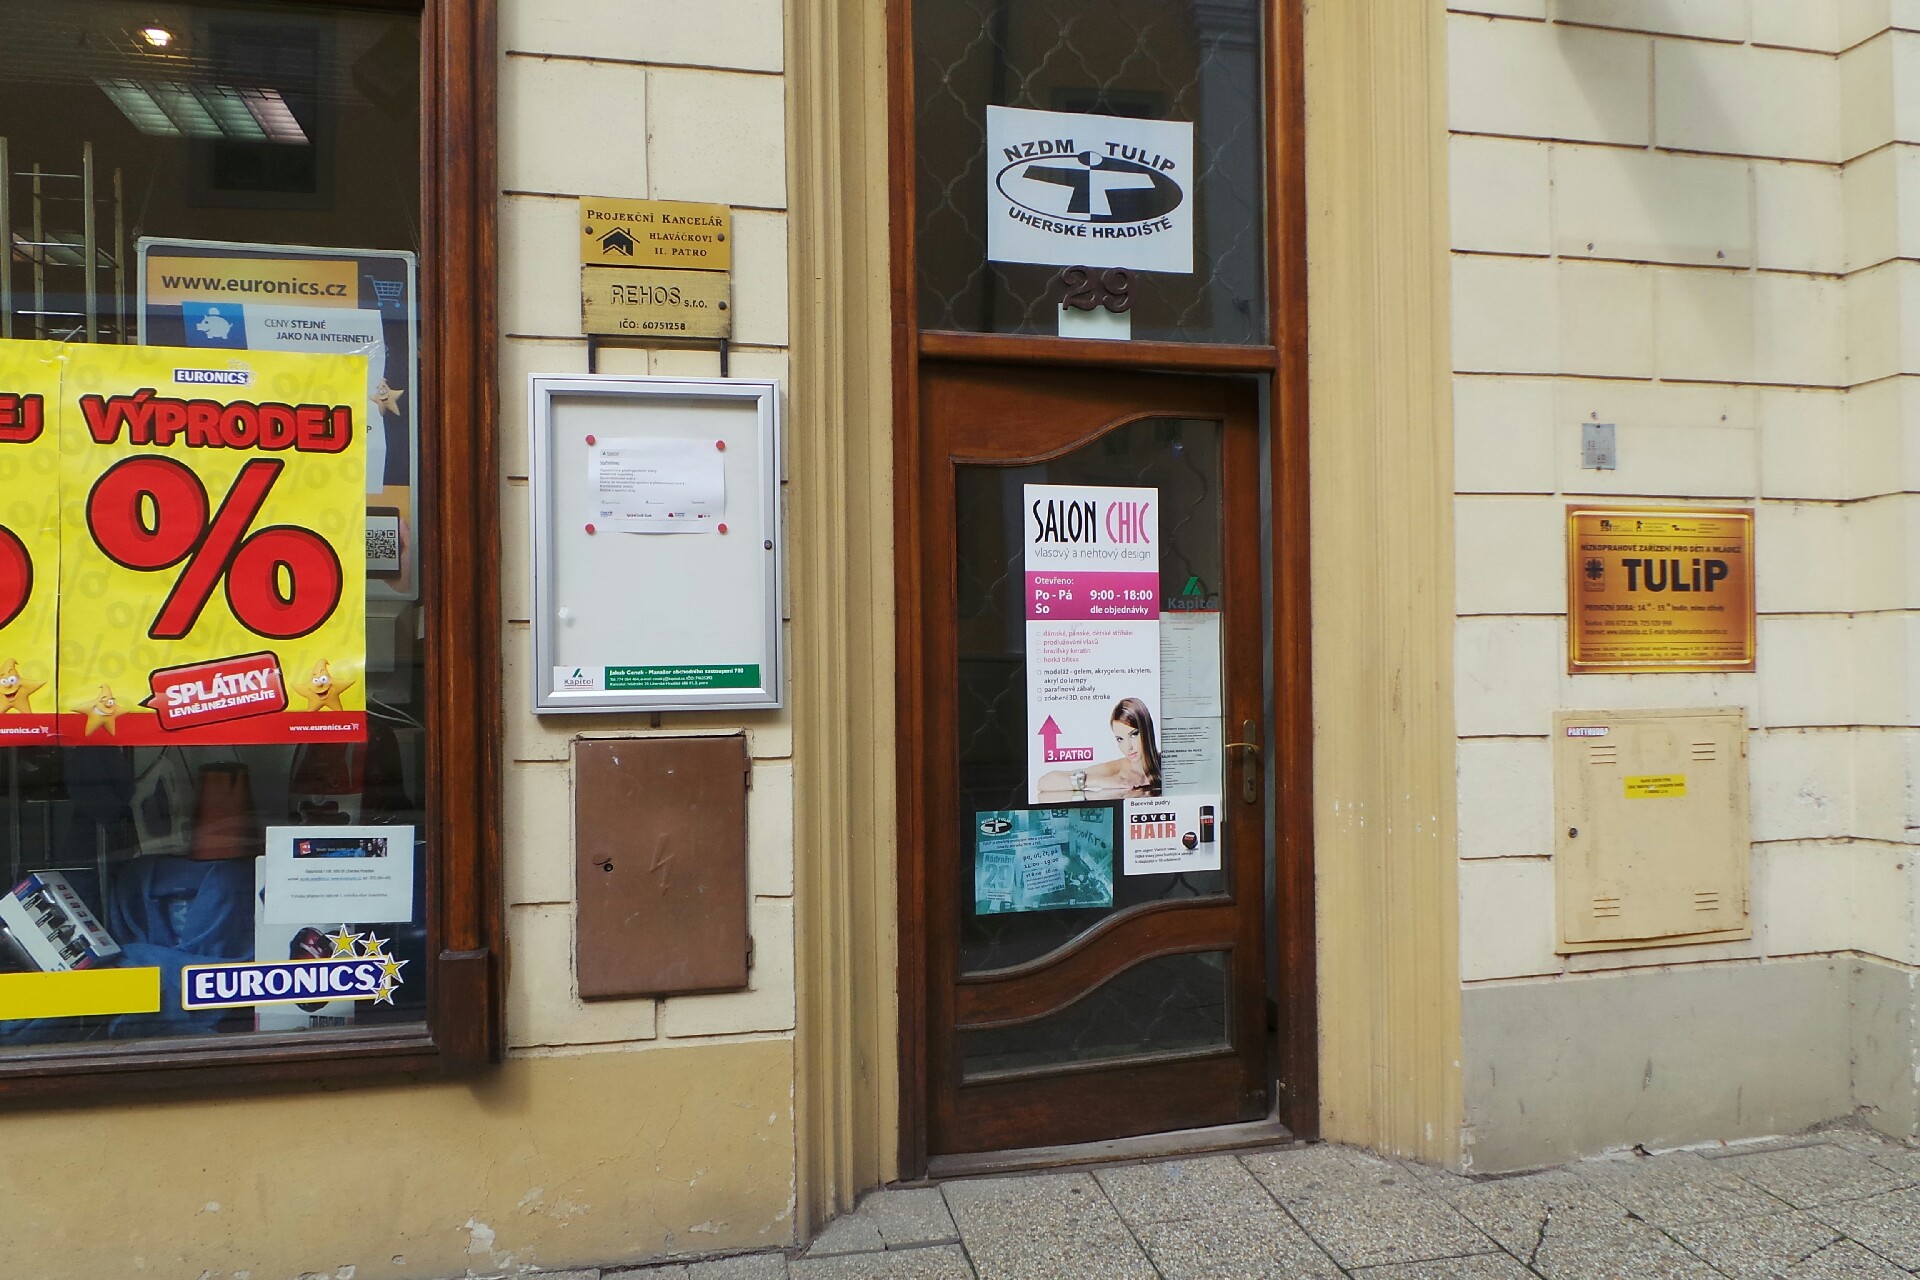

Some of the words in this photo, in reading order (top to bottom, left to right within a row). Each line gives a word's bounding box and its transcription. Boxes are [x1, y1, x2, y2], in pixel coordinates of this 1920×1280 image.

[1003, 139, 1074, 162] NZDM
[1105, 142, 1176, 172] TULIP
[587, 210, 654, 223] PROJEKČNÍ
[662, 215, 723, 227] KANCELÁŘ
[1008, 207, 1087, 237] UHERSKÉ
[1092, 216, 1173, 238] HRADIŠTĚ
[650, 232, 712, 242] HLAVÁČKOVI
[672, 248, 707, 256] PATRO
[161, 274, 347, 297] www.euronics.cz
[1062, 265, 1130, 313] 29
[611, 285, 681, 306] REHOS
[684, 299, 707, 308] s.r.o.
[264, 318, 289, 329] CENY
[290, 318, 326, 330] STEJNÉ
[619, 318, 639, 329] IČO:
[642, 321, 686, 330] 60751258
[277, 331, 303, 342] JAKO
[304, 332, 318, 342] NA
[320, 332, 374, 343] INTERNETU
[176, 370, 247, 383] EURONICS
[80, 388, 353, 453] VÝPRODEJ
[1033, 500, 1096, 543] SALON
[1105, 501, 1150, 544] CHIC
[1035, 548, 1070, 560] vlasový
[1072, 551, 1078, 559] a
[1080, 549, 1119, 560] nehtový
[1121, 549, 1151, 561] design
[1035, 576, 1074, 585] Otevřeno:
[1622, 558, 1728, 592] TULiP
[1035, 590, 1050, 600] Po
[1058, 589, 1073, 600] Pá
[1090, 590, 1114, 600] 9:00
[1123, 590, 1153, 600] 18:00
[1035, 604, 1050, 614] So
[1090, 606, 1103, 614] dle
[1104, 606, 1149, 616] objednávky
[166, 668, 271, 706] SPLÁTKY
[564, 678, 594, 687] Kapitol
[236, 689, 276, 705] MYSLÍTE
[289, 723, 353, 733] www.euronics.cz
[1047, 750, 1058, 761] 3.
[1059, 750, 1092, 761] PATRO
[1132, 813, 1175, 822] cover
[1130, 823, 1176, 840] HAIR
[195, 964, 375, 999] EURONICS
